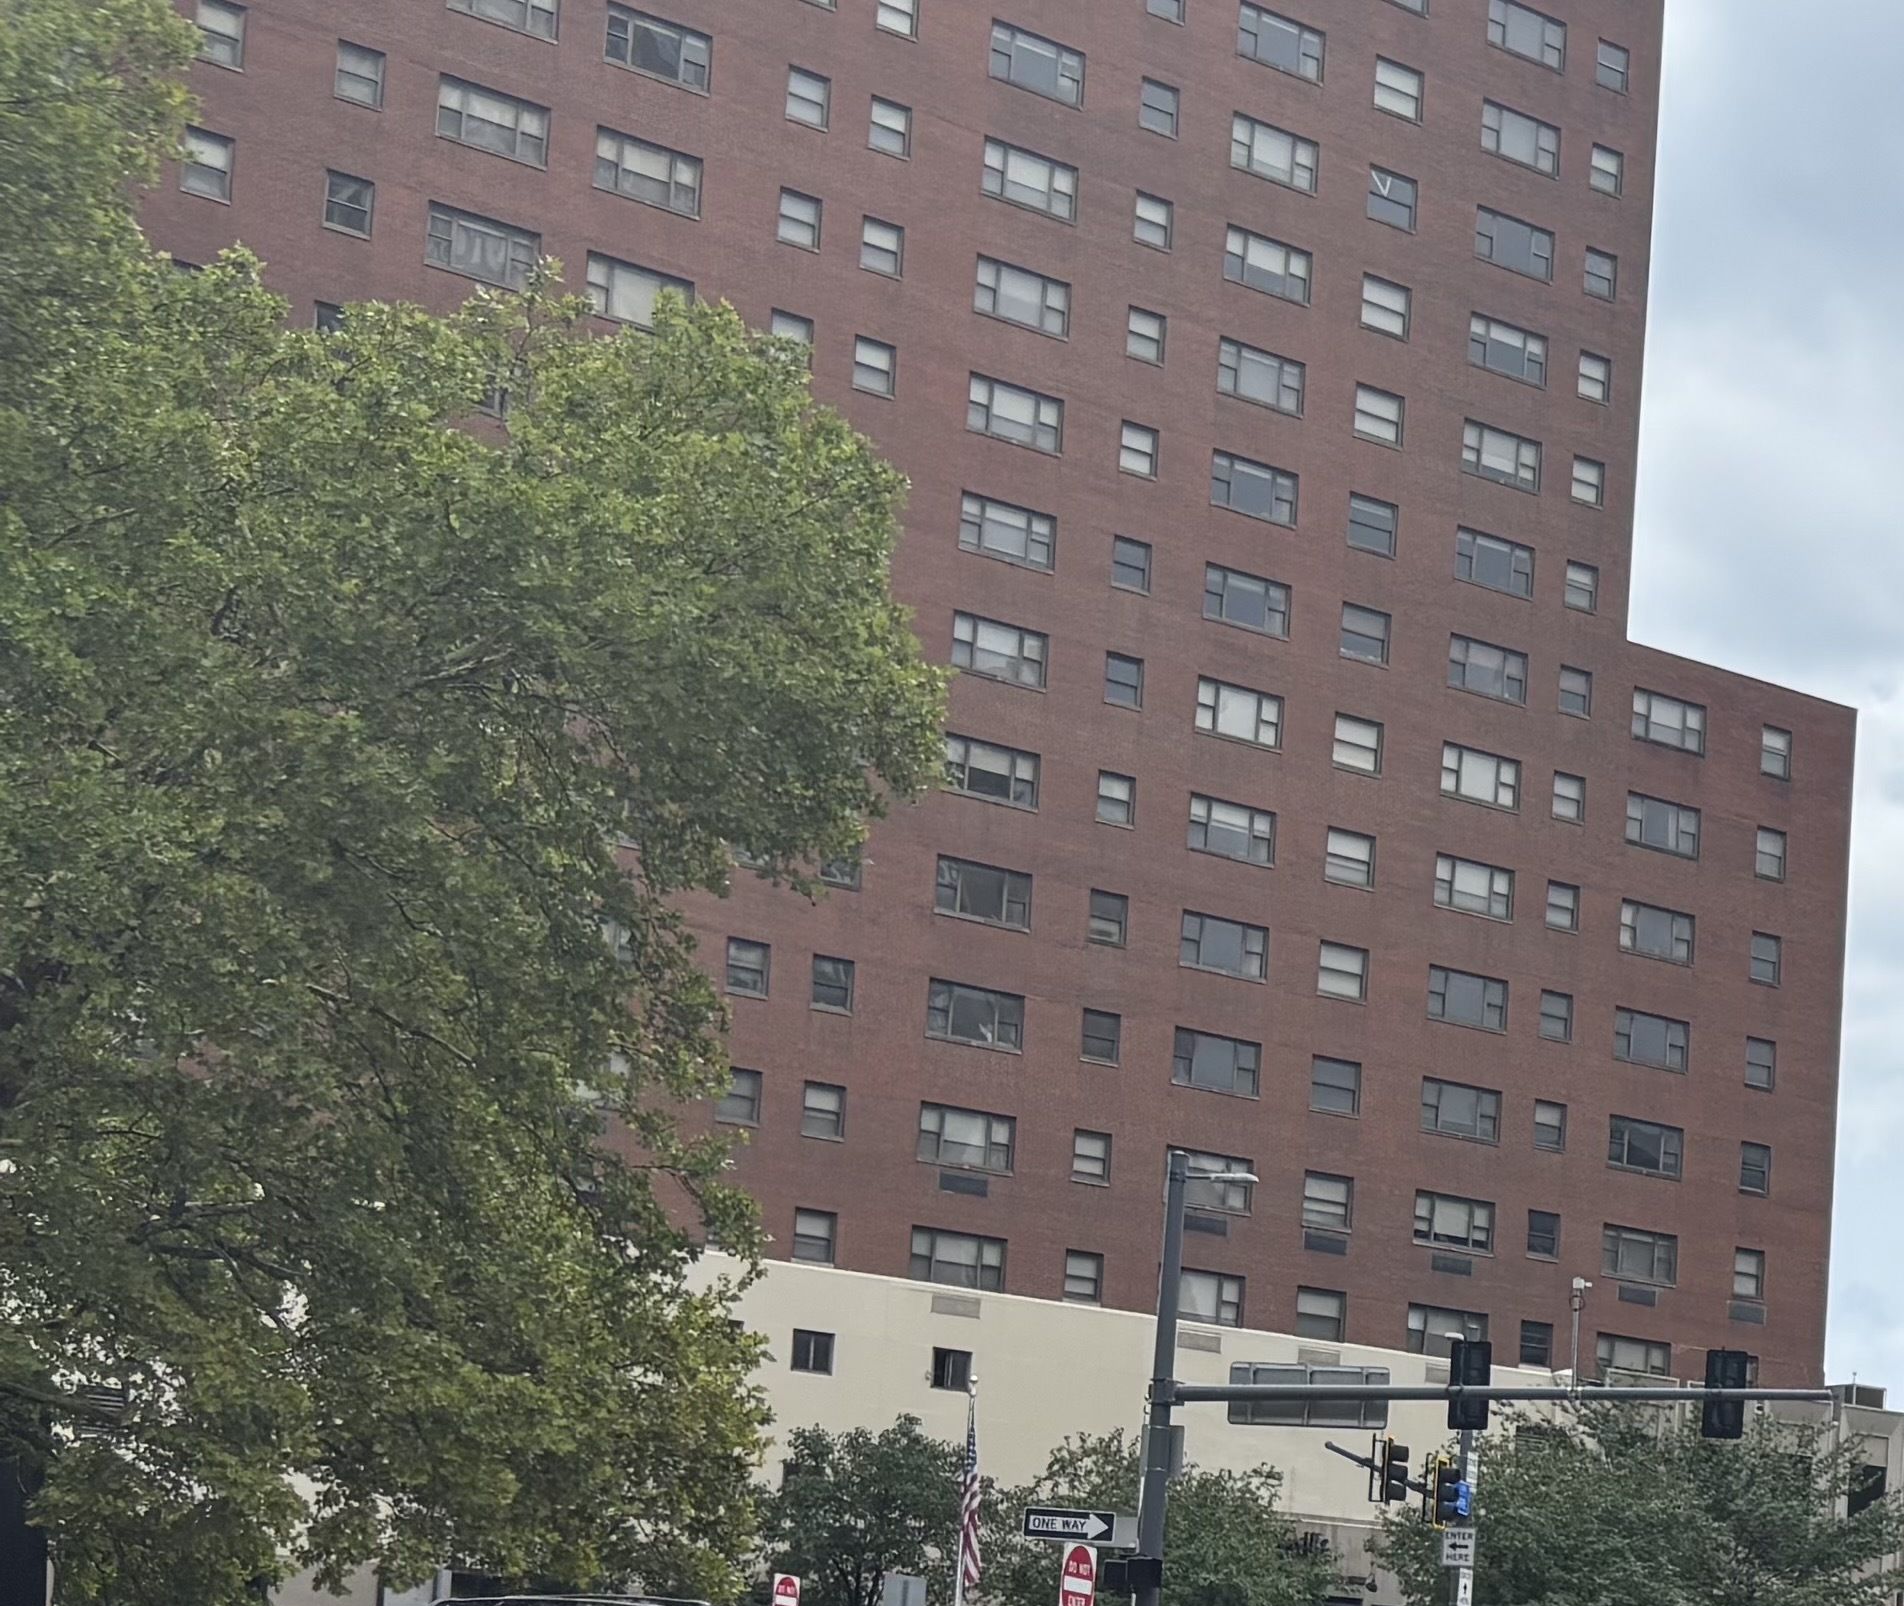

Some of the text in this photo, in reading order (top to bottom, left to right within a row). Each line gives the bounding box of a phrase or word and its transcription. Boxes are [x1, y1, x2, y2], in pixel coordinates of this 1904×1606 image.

[1032, 1517, 1087, 1532] ONE WAY
[1445, 1531, 1473, 1541] ENTER
[1445, 1553, 1470, 1562] HERE
